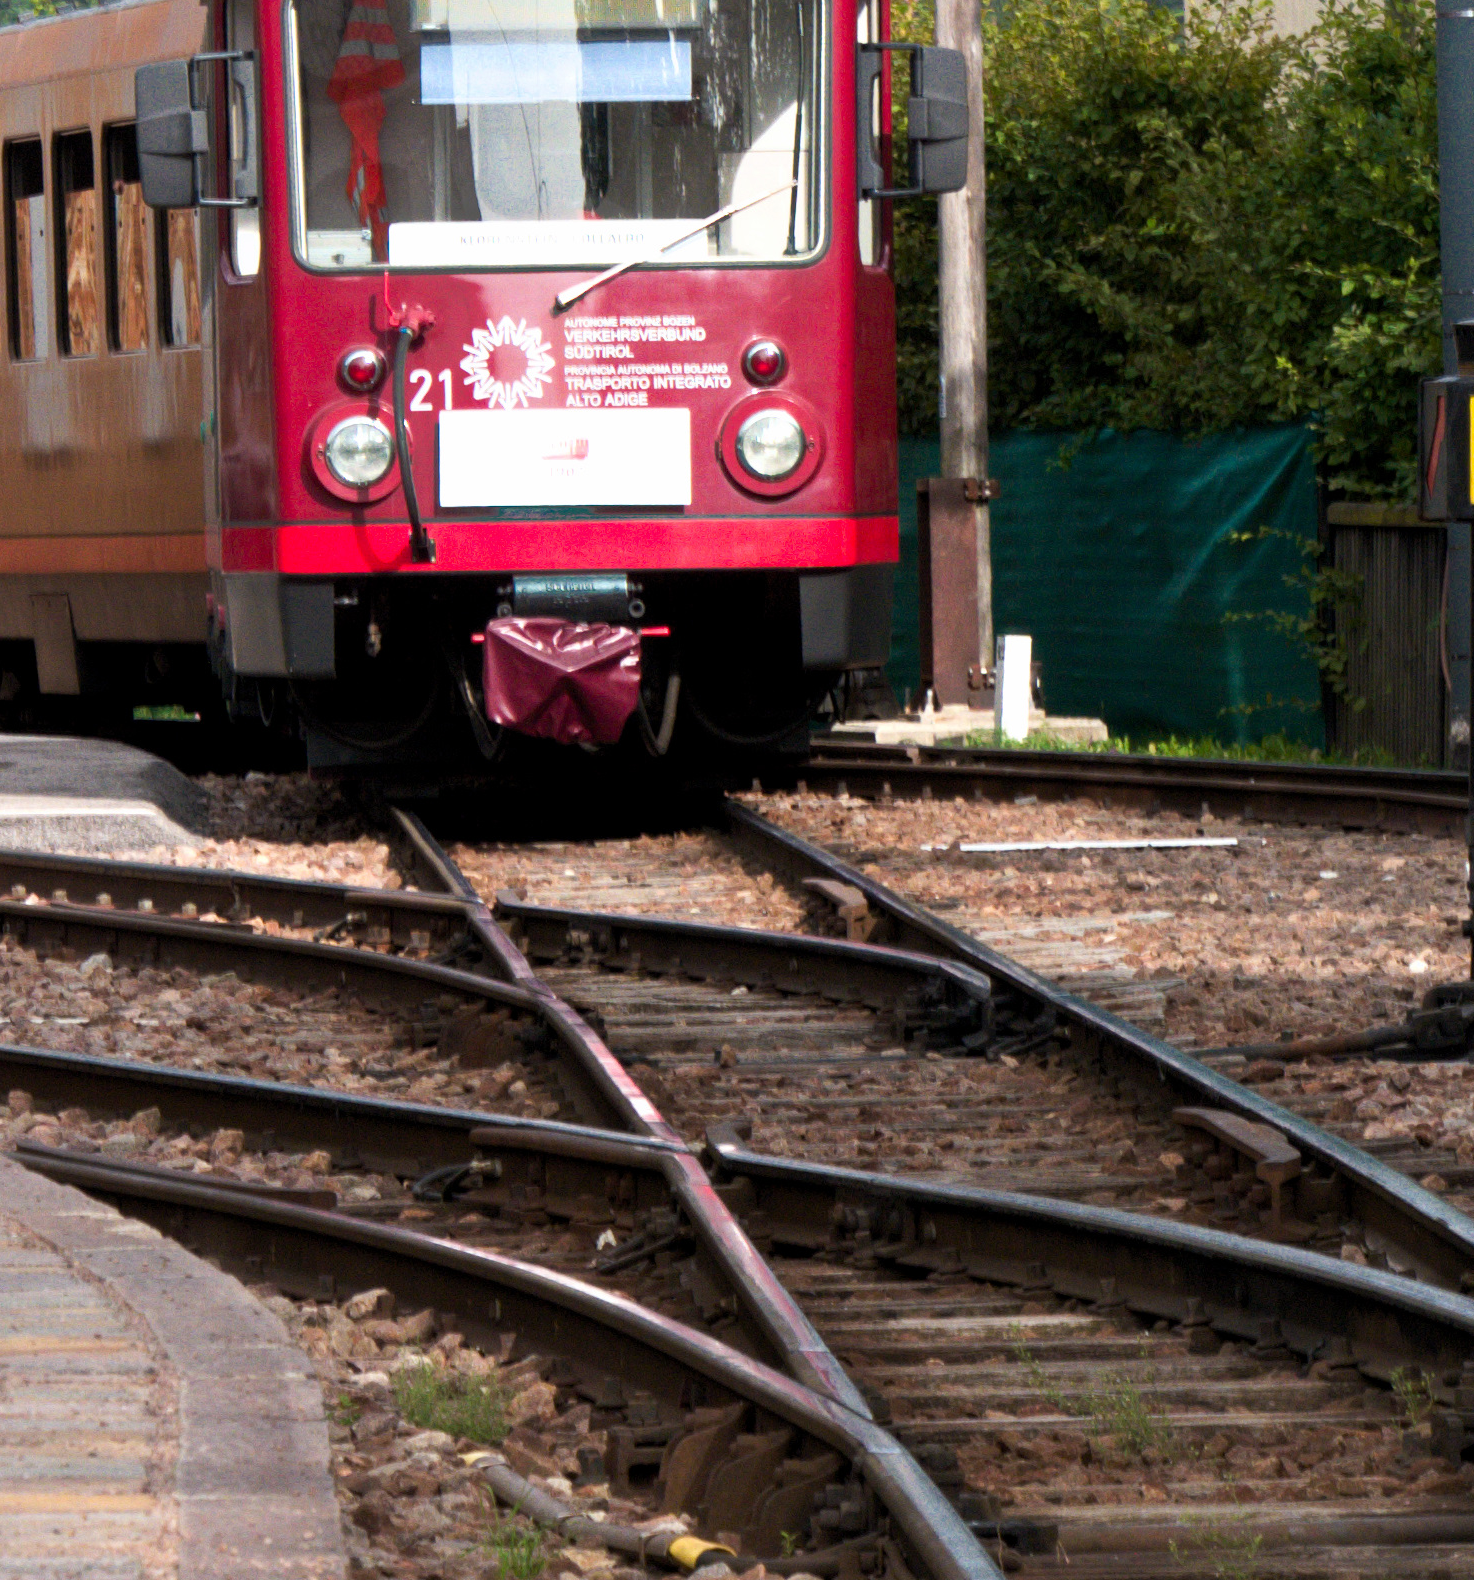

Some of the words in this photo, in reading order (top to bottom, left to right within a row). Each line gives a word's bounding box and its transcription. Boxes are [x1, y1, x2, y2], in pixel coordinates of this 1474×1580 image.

[564, 317, 618, 327] AUTONOME
[620, 316, 661, 326] PROVINZ
[663, 315, 695, 326] BOZEN
[564, 327, 706, 342] VERKEHRSVERBUND
[564, 344, 635, 359] SÜDTIROL
[564, 365, 616, 376] PROVINCIA
[617, 364, 671, 375] AUTONOMA
[672, 363, 682, 374] DI
[684, 363, 728, 374] BOLZANO
[409, 368, 453, 411] 21
[565, 376, 650, 390] TRASPORTO
[654, 375, 732, 389] INTEGRATO
[566, 392, 602, 407] ALTO
[605, 391, 649, 406] ADIGE
